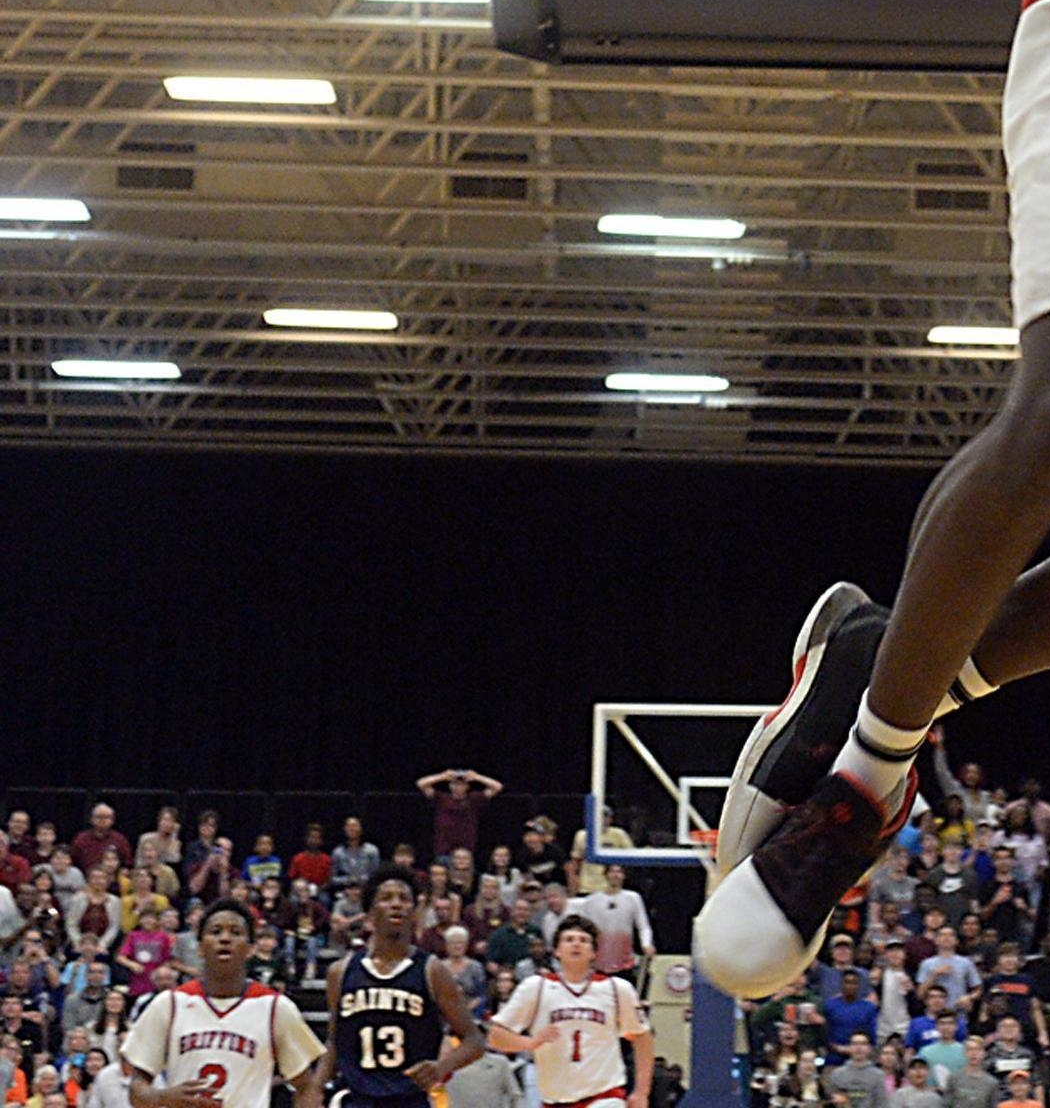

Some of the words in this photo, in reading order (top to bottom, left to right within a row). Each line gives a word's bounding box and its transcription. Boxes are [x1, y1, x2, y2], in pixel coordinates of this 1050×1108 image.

[340, 987, 424, 1017] SAINTS
[359, 1025, 405, 1069] 13
[571, 1029, 581, 1062] 1
[198, 1062, 228, 1106] 2
